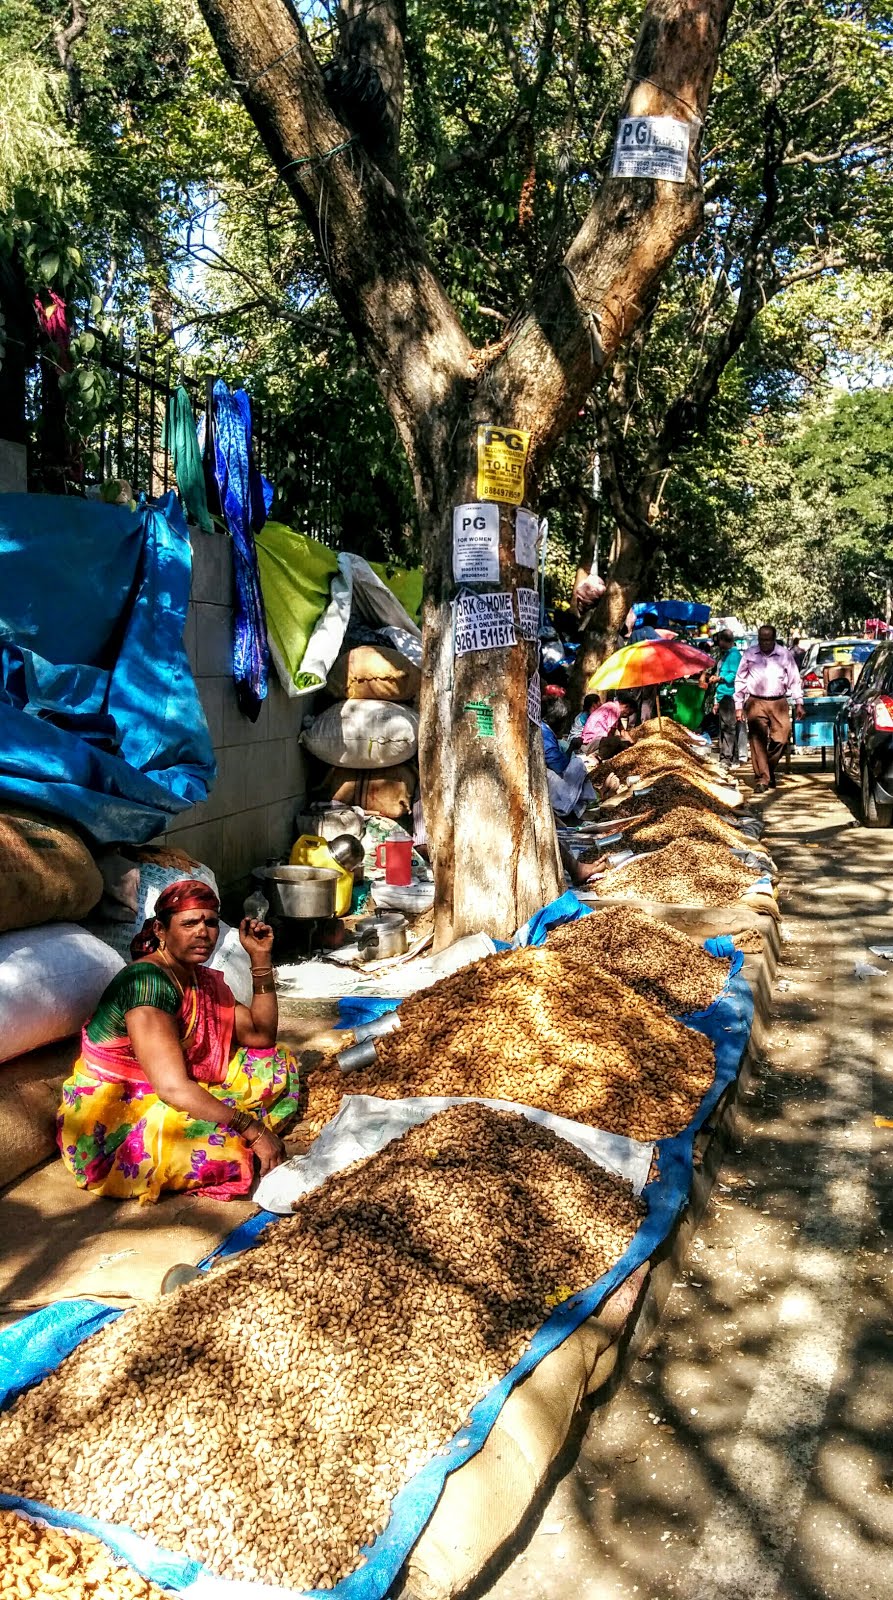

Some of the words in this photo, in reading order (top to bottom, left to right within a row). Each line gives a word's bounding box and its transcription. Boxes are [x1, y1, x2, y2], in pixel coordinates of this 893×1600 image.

[485, 430, 524, 451] PG
[462, 516, 486, 531] PG
[479, 620, 498, 629] ONLINE
[455, 630, 478, 651] 9261
[480, 625, 515, 648] 511511
